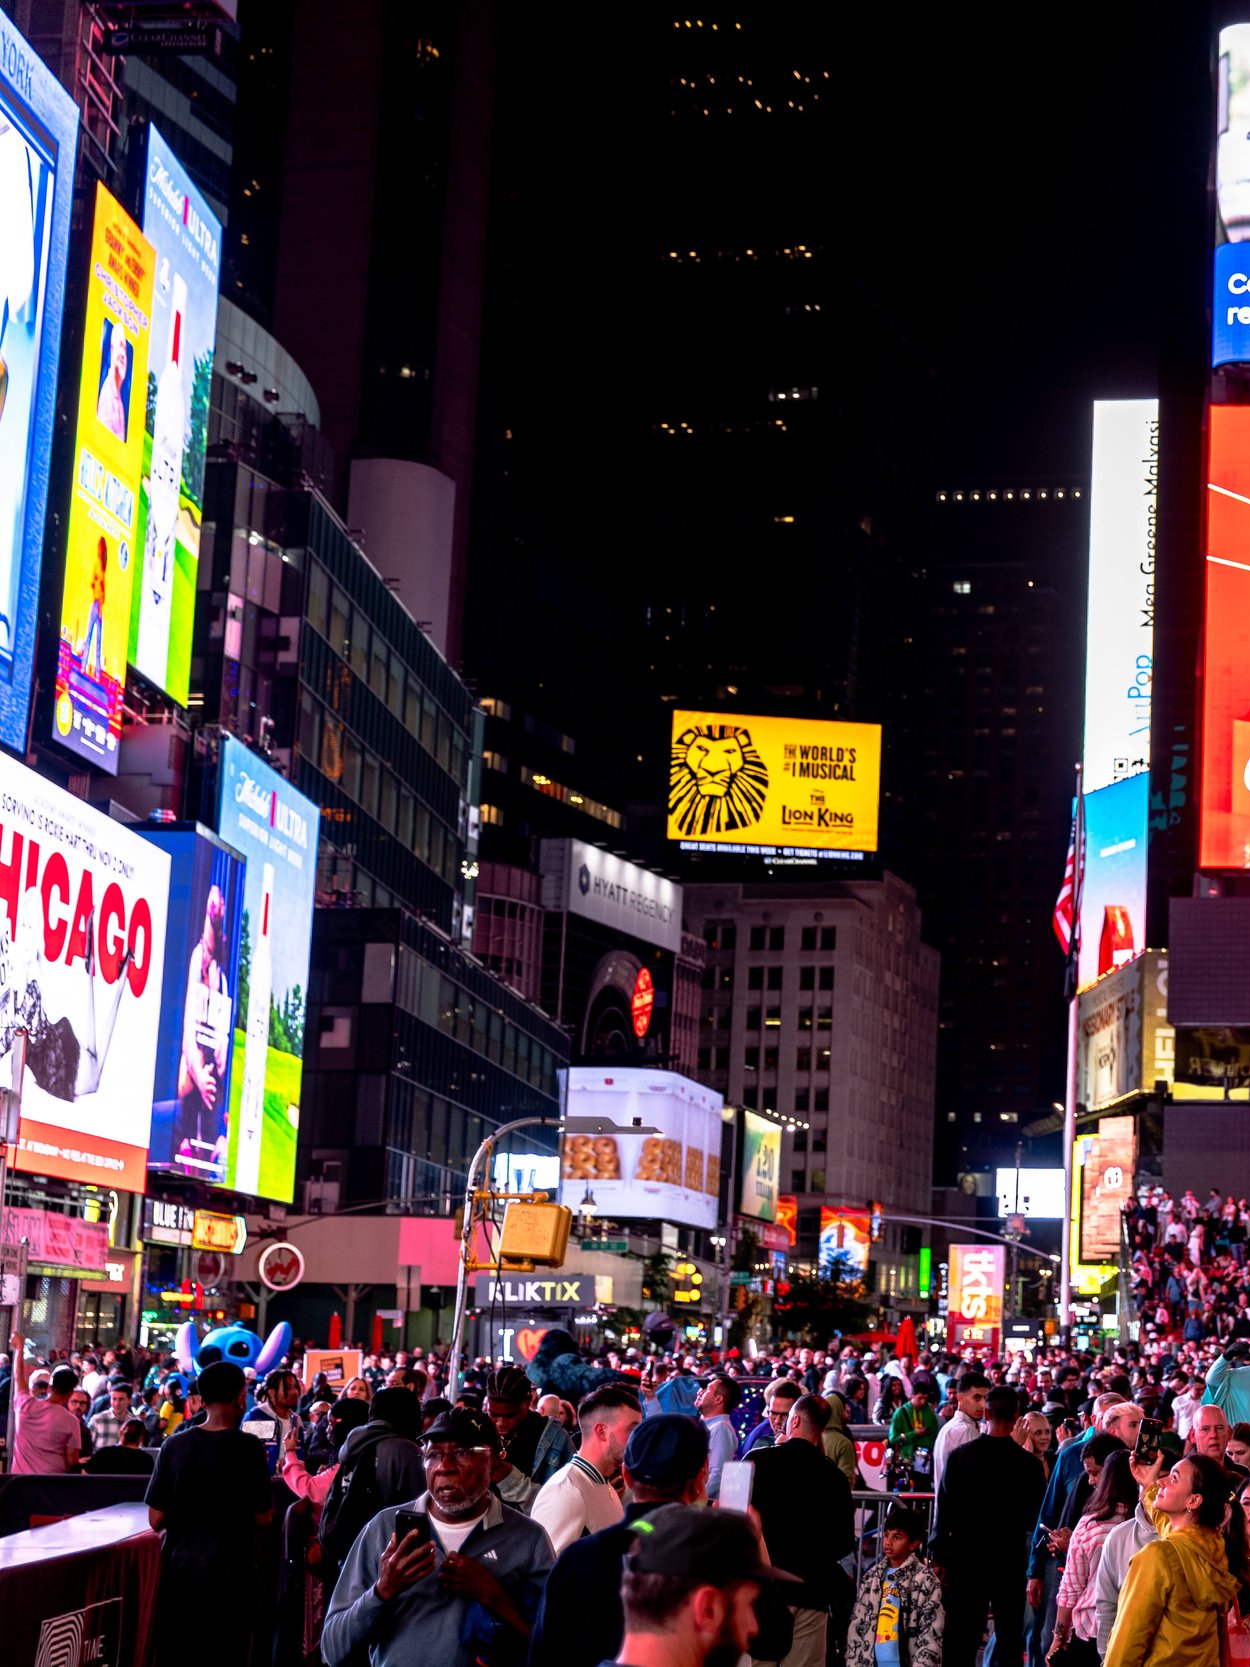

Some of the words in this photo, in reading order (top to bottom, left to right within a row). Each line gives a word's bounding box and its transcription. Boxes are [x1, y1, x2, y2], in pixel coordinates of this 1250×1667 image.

[799, 745, 857, 764] WORLD'S
[799, 762, 857, 781] MUSICAL
[276, 799, 308, 850] ULTRA
[782, 804, 814, 825] LION
[817, 807, 854, 828] KING
[593, 876, 629, 905] HYATT
[630, 889, 674, 923] REGENCY
[488, 1281, 581, 1302] KLIKTIX
[961, 1250, 997, 1319] tkts
